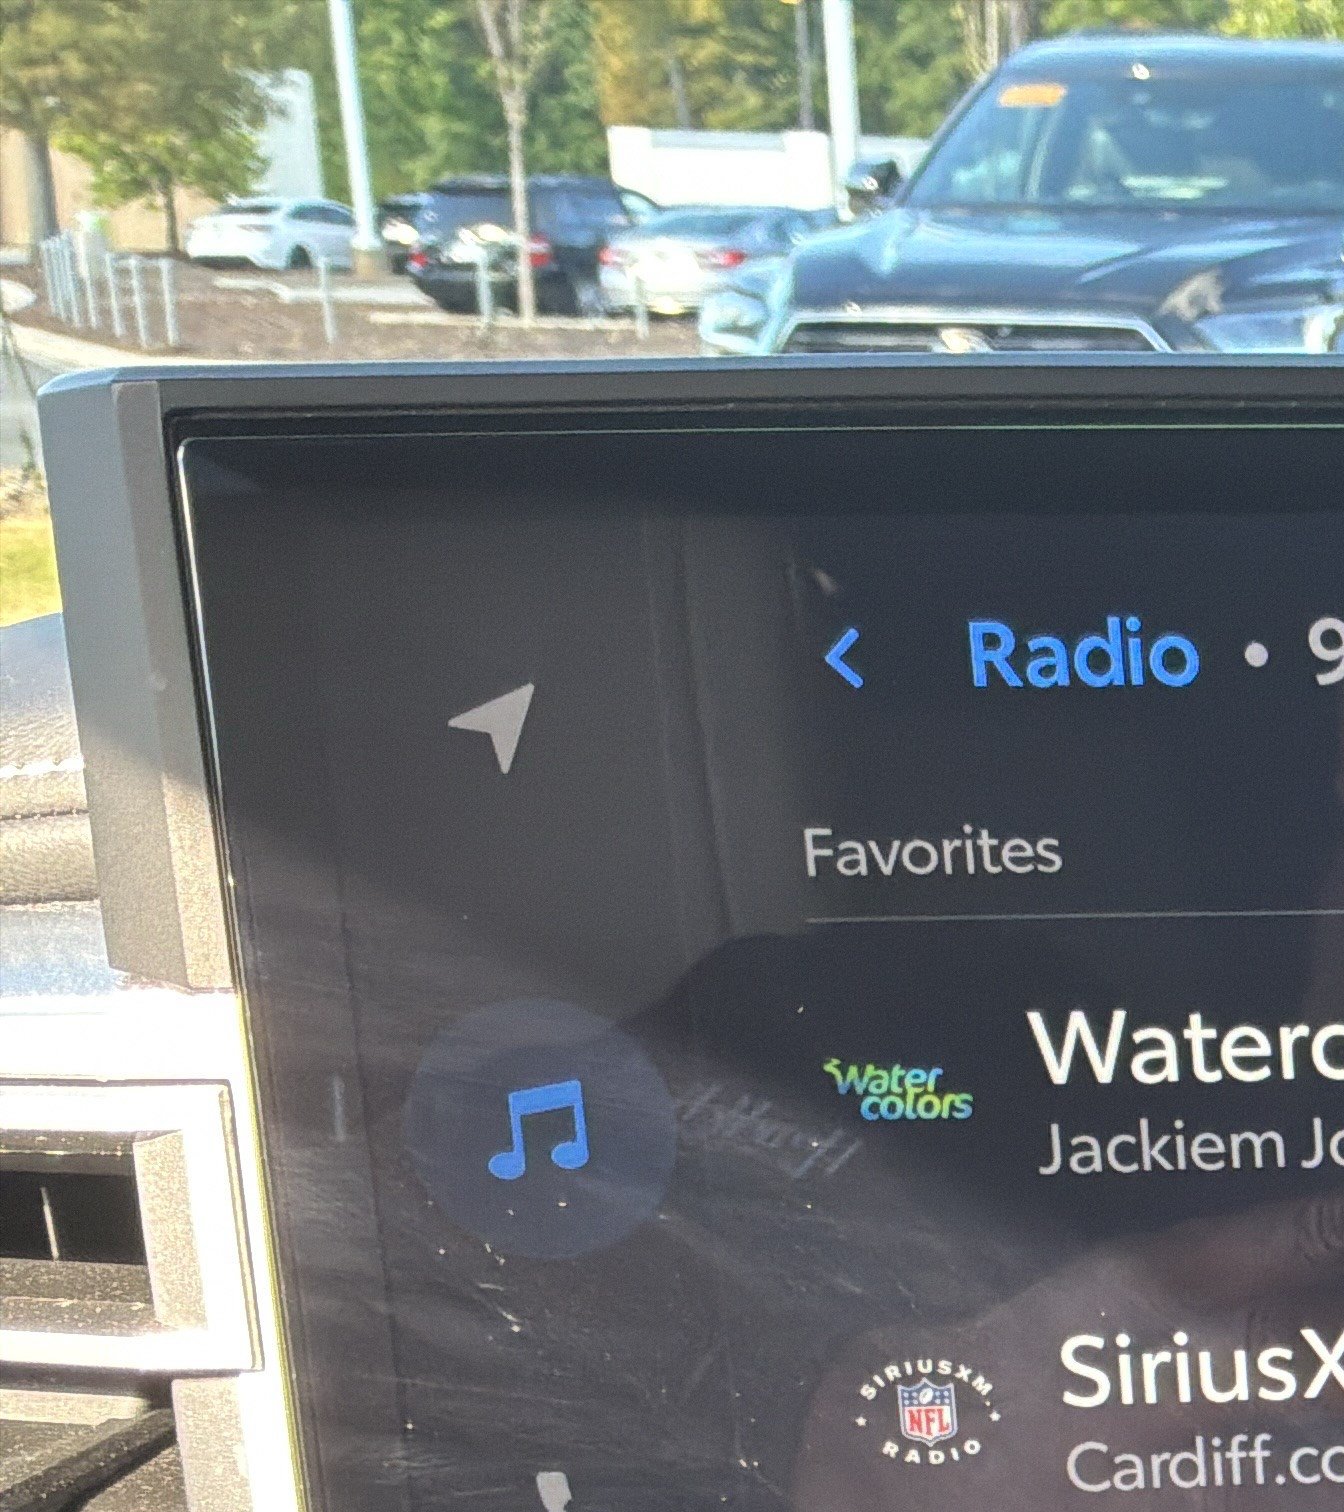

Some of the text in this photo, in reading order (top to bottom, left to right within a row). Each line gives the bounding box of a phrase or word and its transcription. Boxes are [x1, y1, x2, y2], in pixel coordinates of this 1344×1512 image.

[968, 615, 1200, 689] Radio
[803, 827, 1063, 877] Favorites
[823, 1058, 944, 1095] Water
[860, 1090, 974, 1121] colors
[1039, 1117, 1286, 1175] Jackiem
[860, 1359, 993, 1400] SIRIUSXM
[908, 1407, 950, 1436] NFL
[882, 1439, 982, 1465] RADIO
